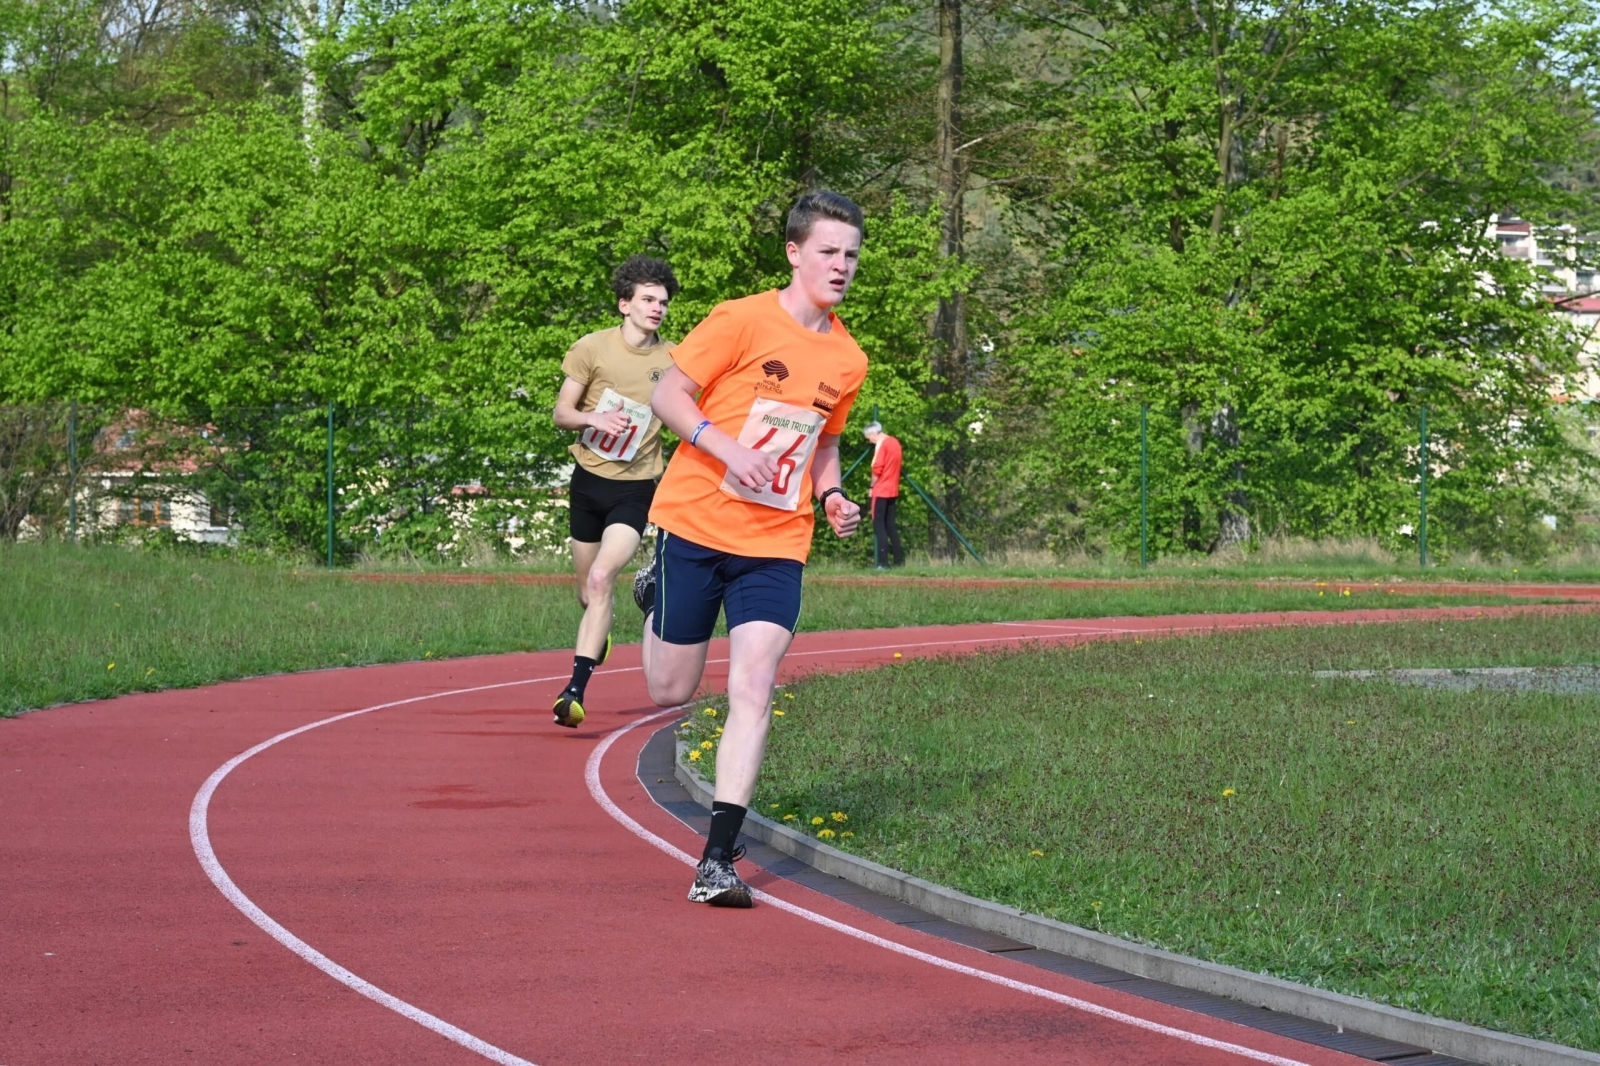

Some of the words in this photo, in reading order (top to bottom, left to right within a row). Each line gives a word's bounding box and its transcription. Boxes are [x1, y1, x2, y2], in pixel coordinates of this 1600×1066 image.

[756, 382, 783, 395] ATHLETICS
[763, 379, 781, 389] WORLD
[762, 414, 790, 428] PIVOVAR
